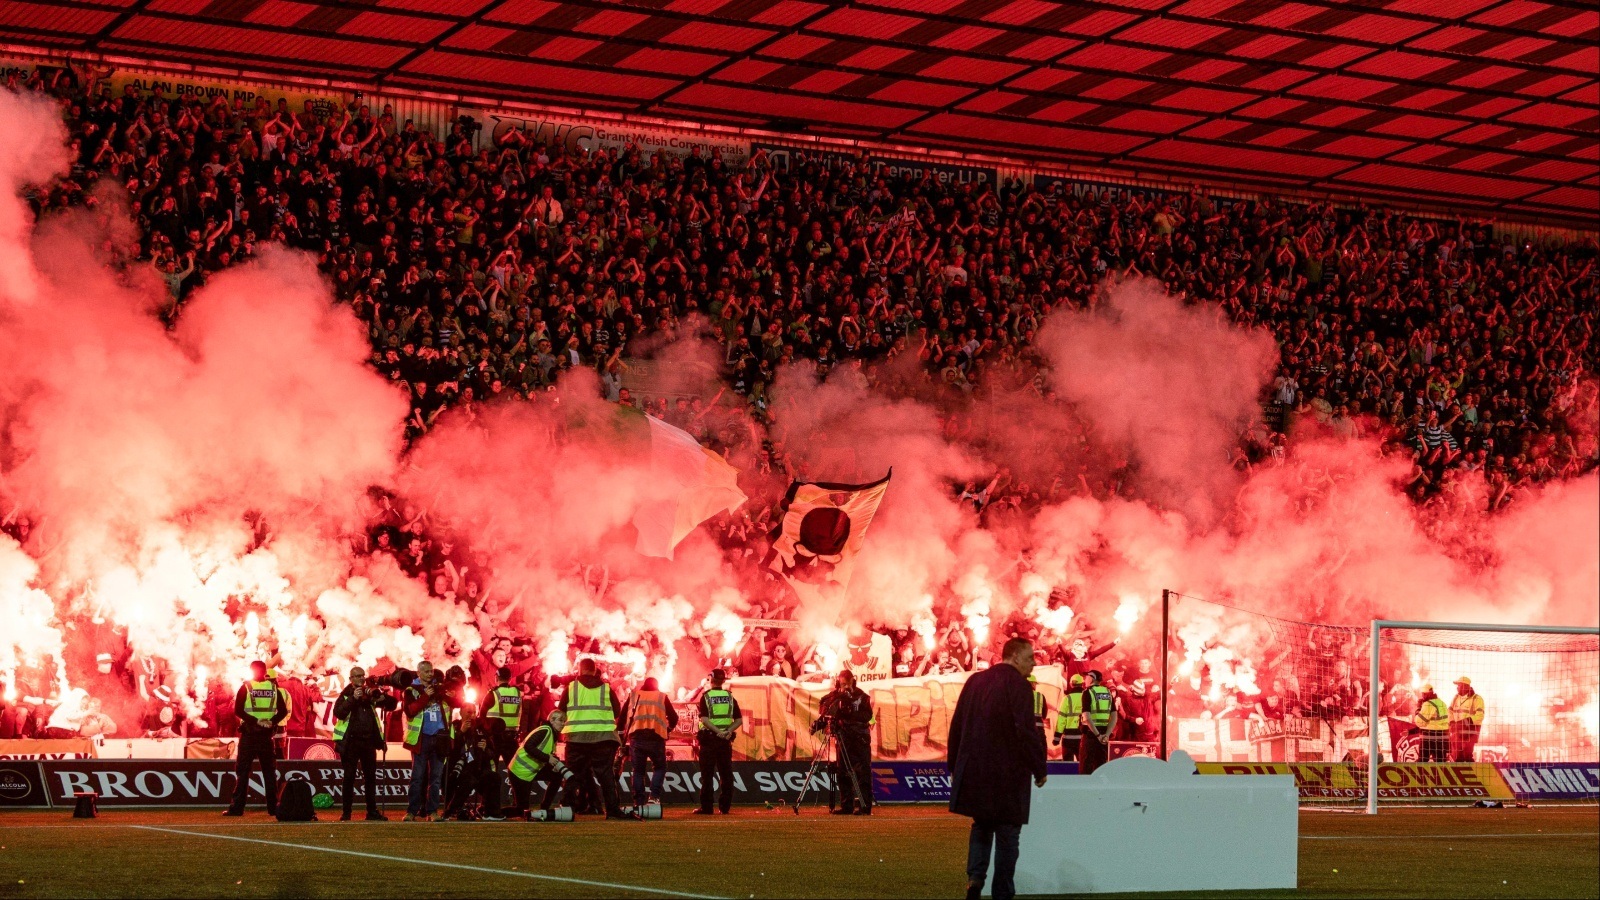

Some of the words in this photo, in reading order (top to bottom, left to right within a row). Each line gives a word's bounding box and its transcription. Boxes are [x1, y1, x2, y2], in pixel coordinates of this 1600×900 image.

[132, 78, 172, 94] ALAN
[176, 83, 228, 100] BROWN
[233, 90, 255, 102] MP
[596, 129, 631, 143] Grant
[634, 133, 667, 147] Welsh
[875, 161, 954, 184] Dempter
[860, 672, 887, 682] CREW
[500, 696, 521, 704] POLICE
[318, 768, 413, 781] PRESUR
[753, 771, 840, 792] SIGN
[1320, 788, 1409, 798] PROJCTS
[1418, 788, 1484, 797] LIMITED
